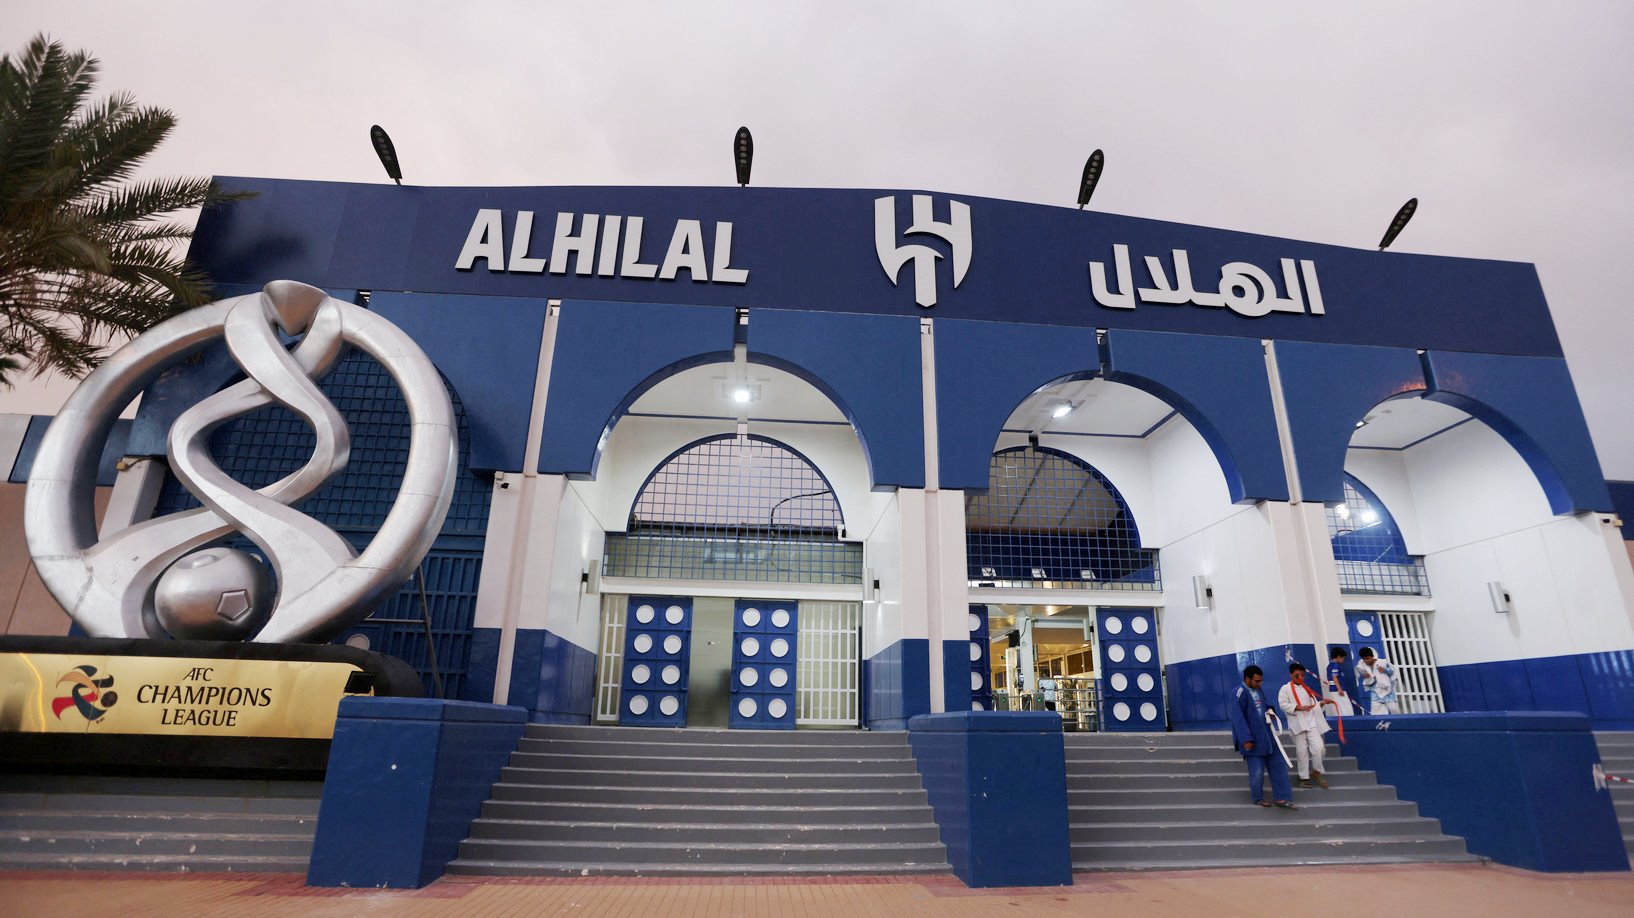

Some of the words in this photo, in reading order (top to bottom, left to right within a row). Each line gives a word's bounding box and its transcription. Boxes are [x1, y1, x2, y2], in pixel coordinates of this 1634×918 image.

[455, 208, 749, 284] ALHILAL
[1089, 243, 1326, 317] الهلال
[183, 667, 214, 682] AFC
[136, 684, 272, 707] CHAMPIONS
[161, 708, 238, 727] LEAGUE
